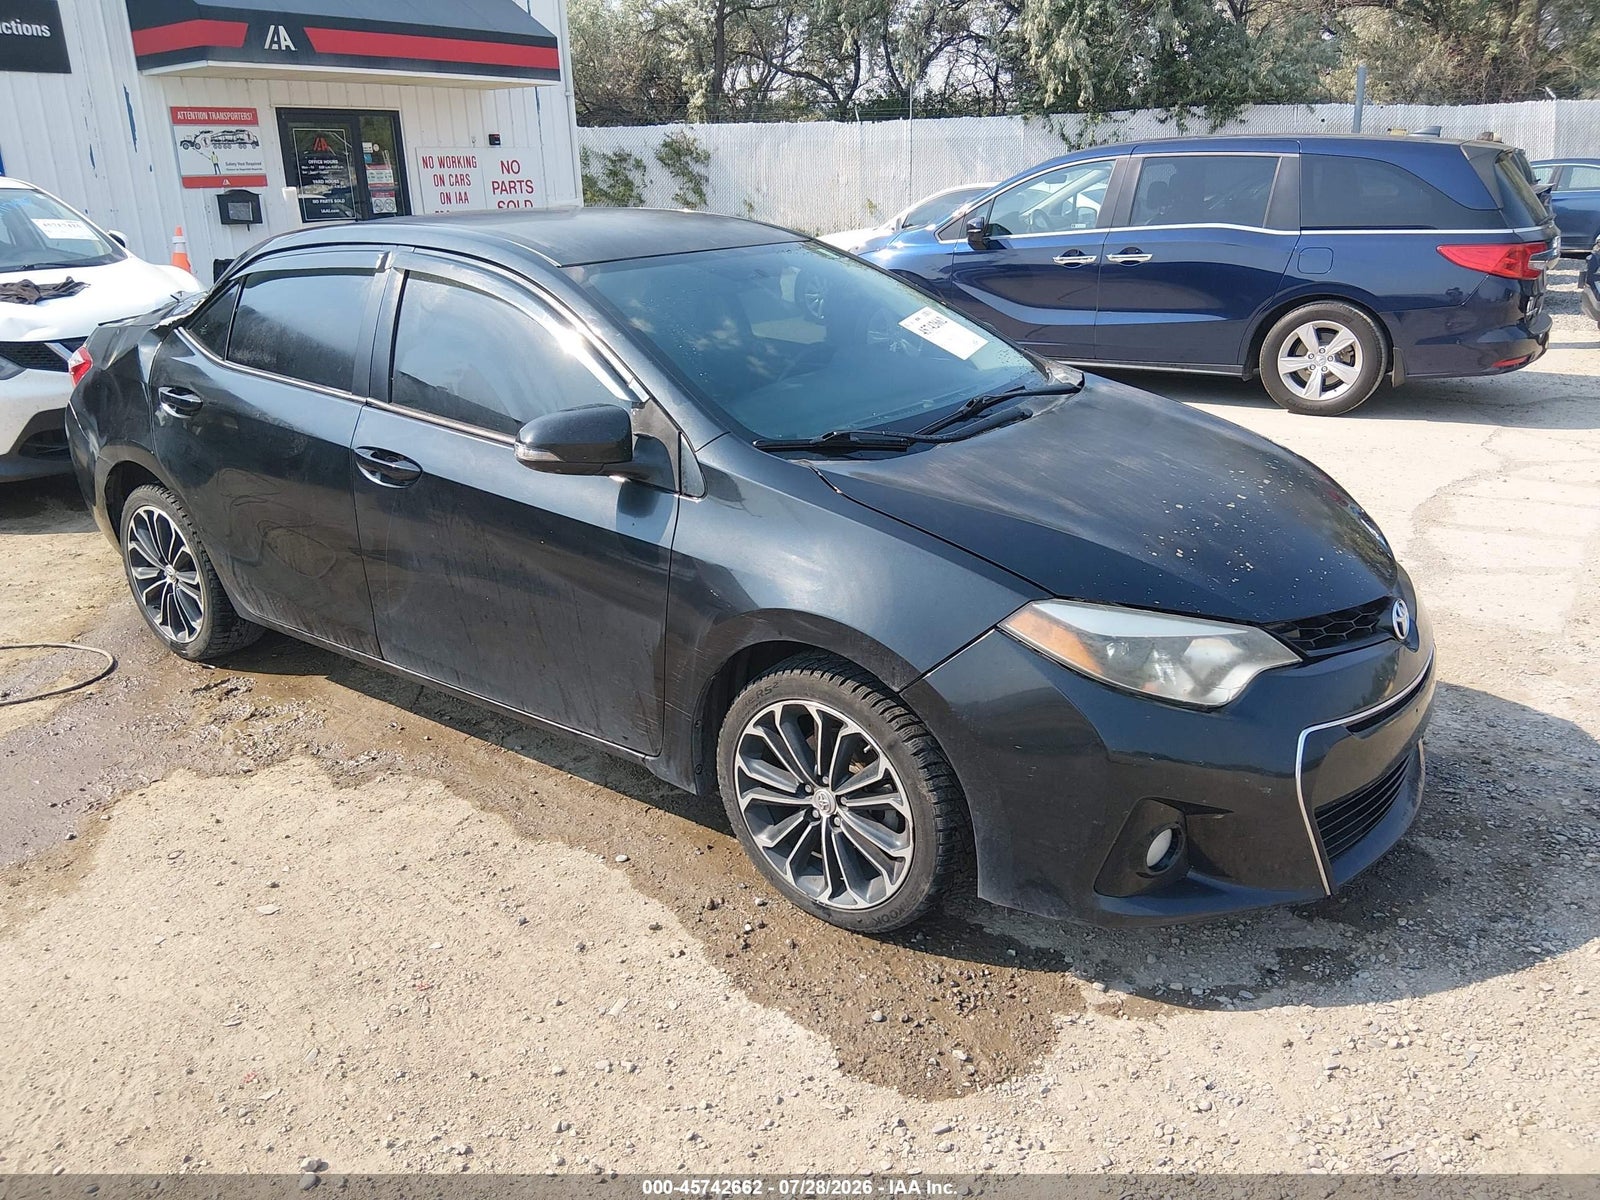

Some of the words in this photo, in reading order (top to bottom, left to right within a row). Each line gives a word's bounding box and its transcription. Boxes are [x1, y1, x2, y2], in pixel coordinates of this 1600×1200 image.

[0, 19, 51, 37] ctions
[177, 111, 208, 120] ATTENTION
[208, 112, 253, 120] TRANSPORTERS!
[422, 156, 435, 169] NO
[437, 155, 477, 168] WORKING
[500, 160, 520, 174] NO
[433, 174, 446, 187] ON
[449, 173, 471, 186] CARS
[491, 180, 534, 195] PARTS
[440, 192, 452, 205] ON
[455, 191, 469, 204] IAA
